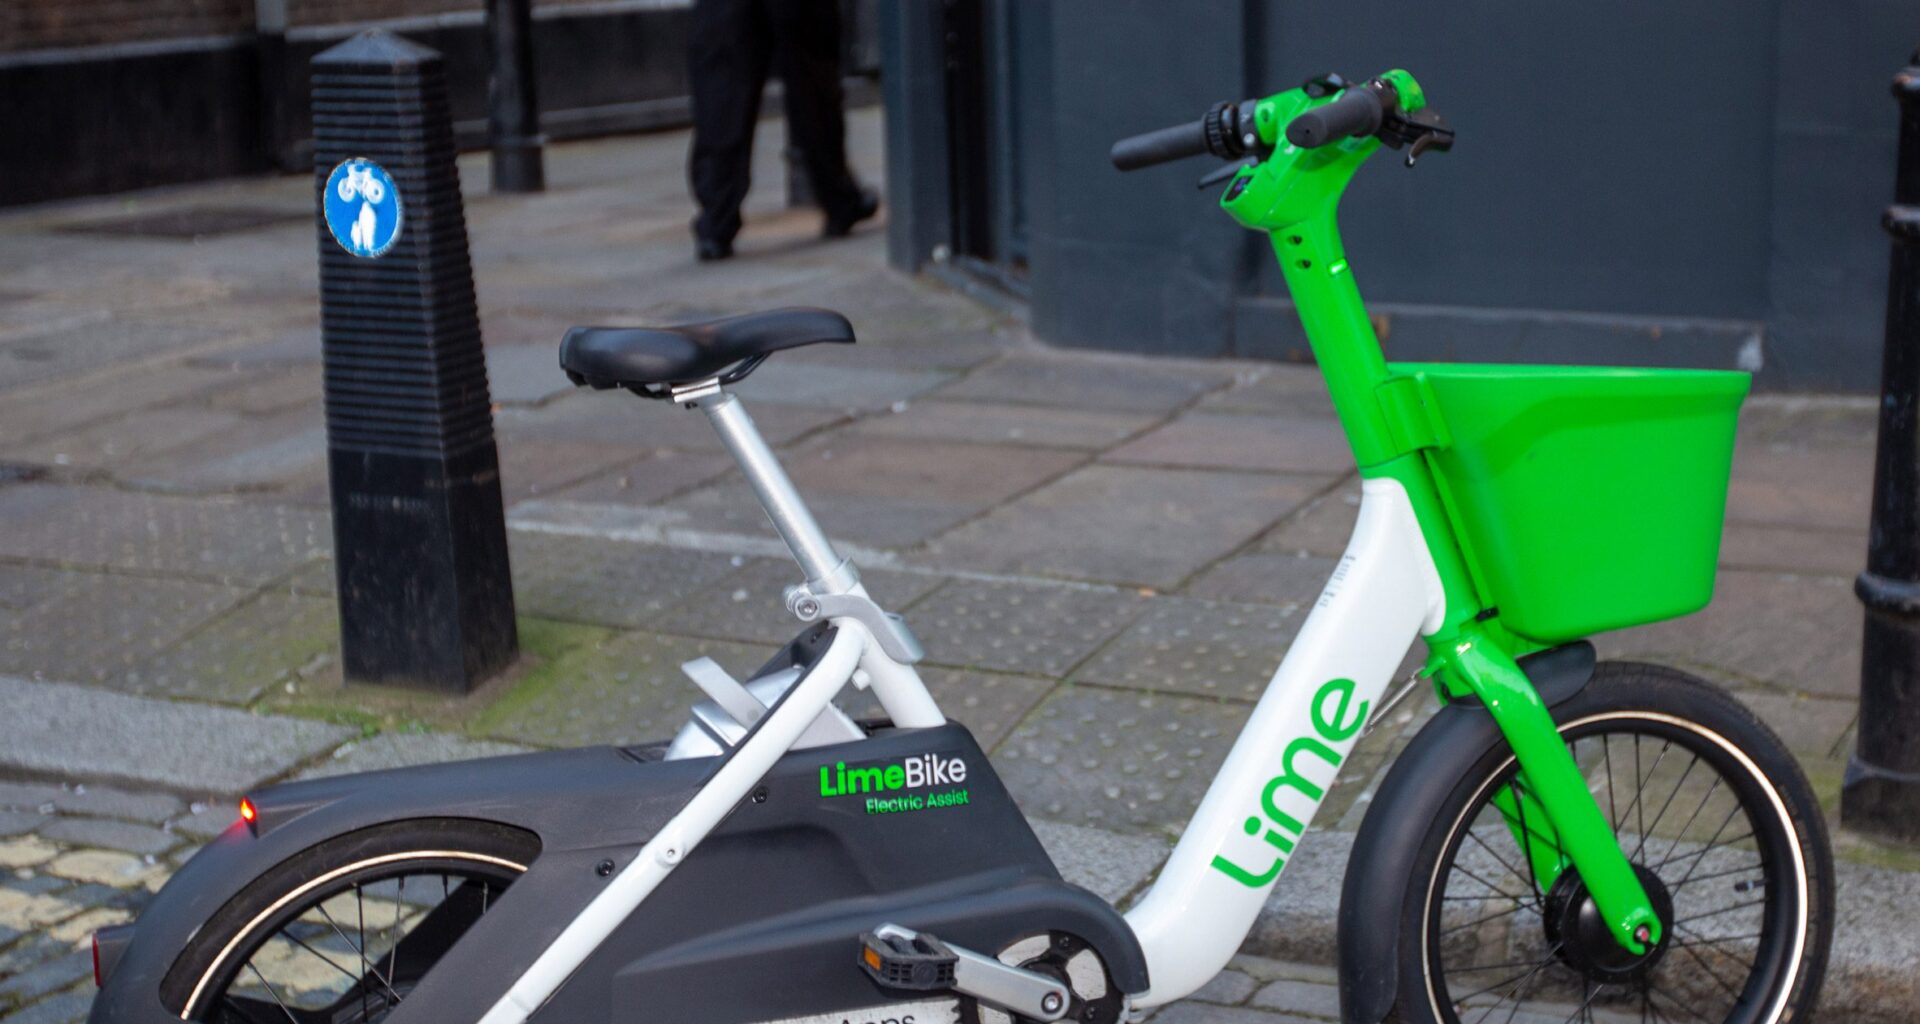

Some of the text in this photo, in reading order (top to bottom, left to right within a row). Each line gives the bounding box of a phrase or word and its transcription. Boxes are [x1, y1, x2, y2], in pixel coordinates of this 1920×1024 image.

[819, 753, 967, 797] LimeBike
[1210, 678, 1370, 888] Lime
[865, 789, 970, 815] Electric Assist
